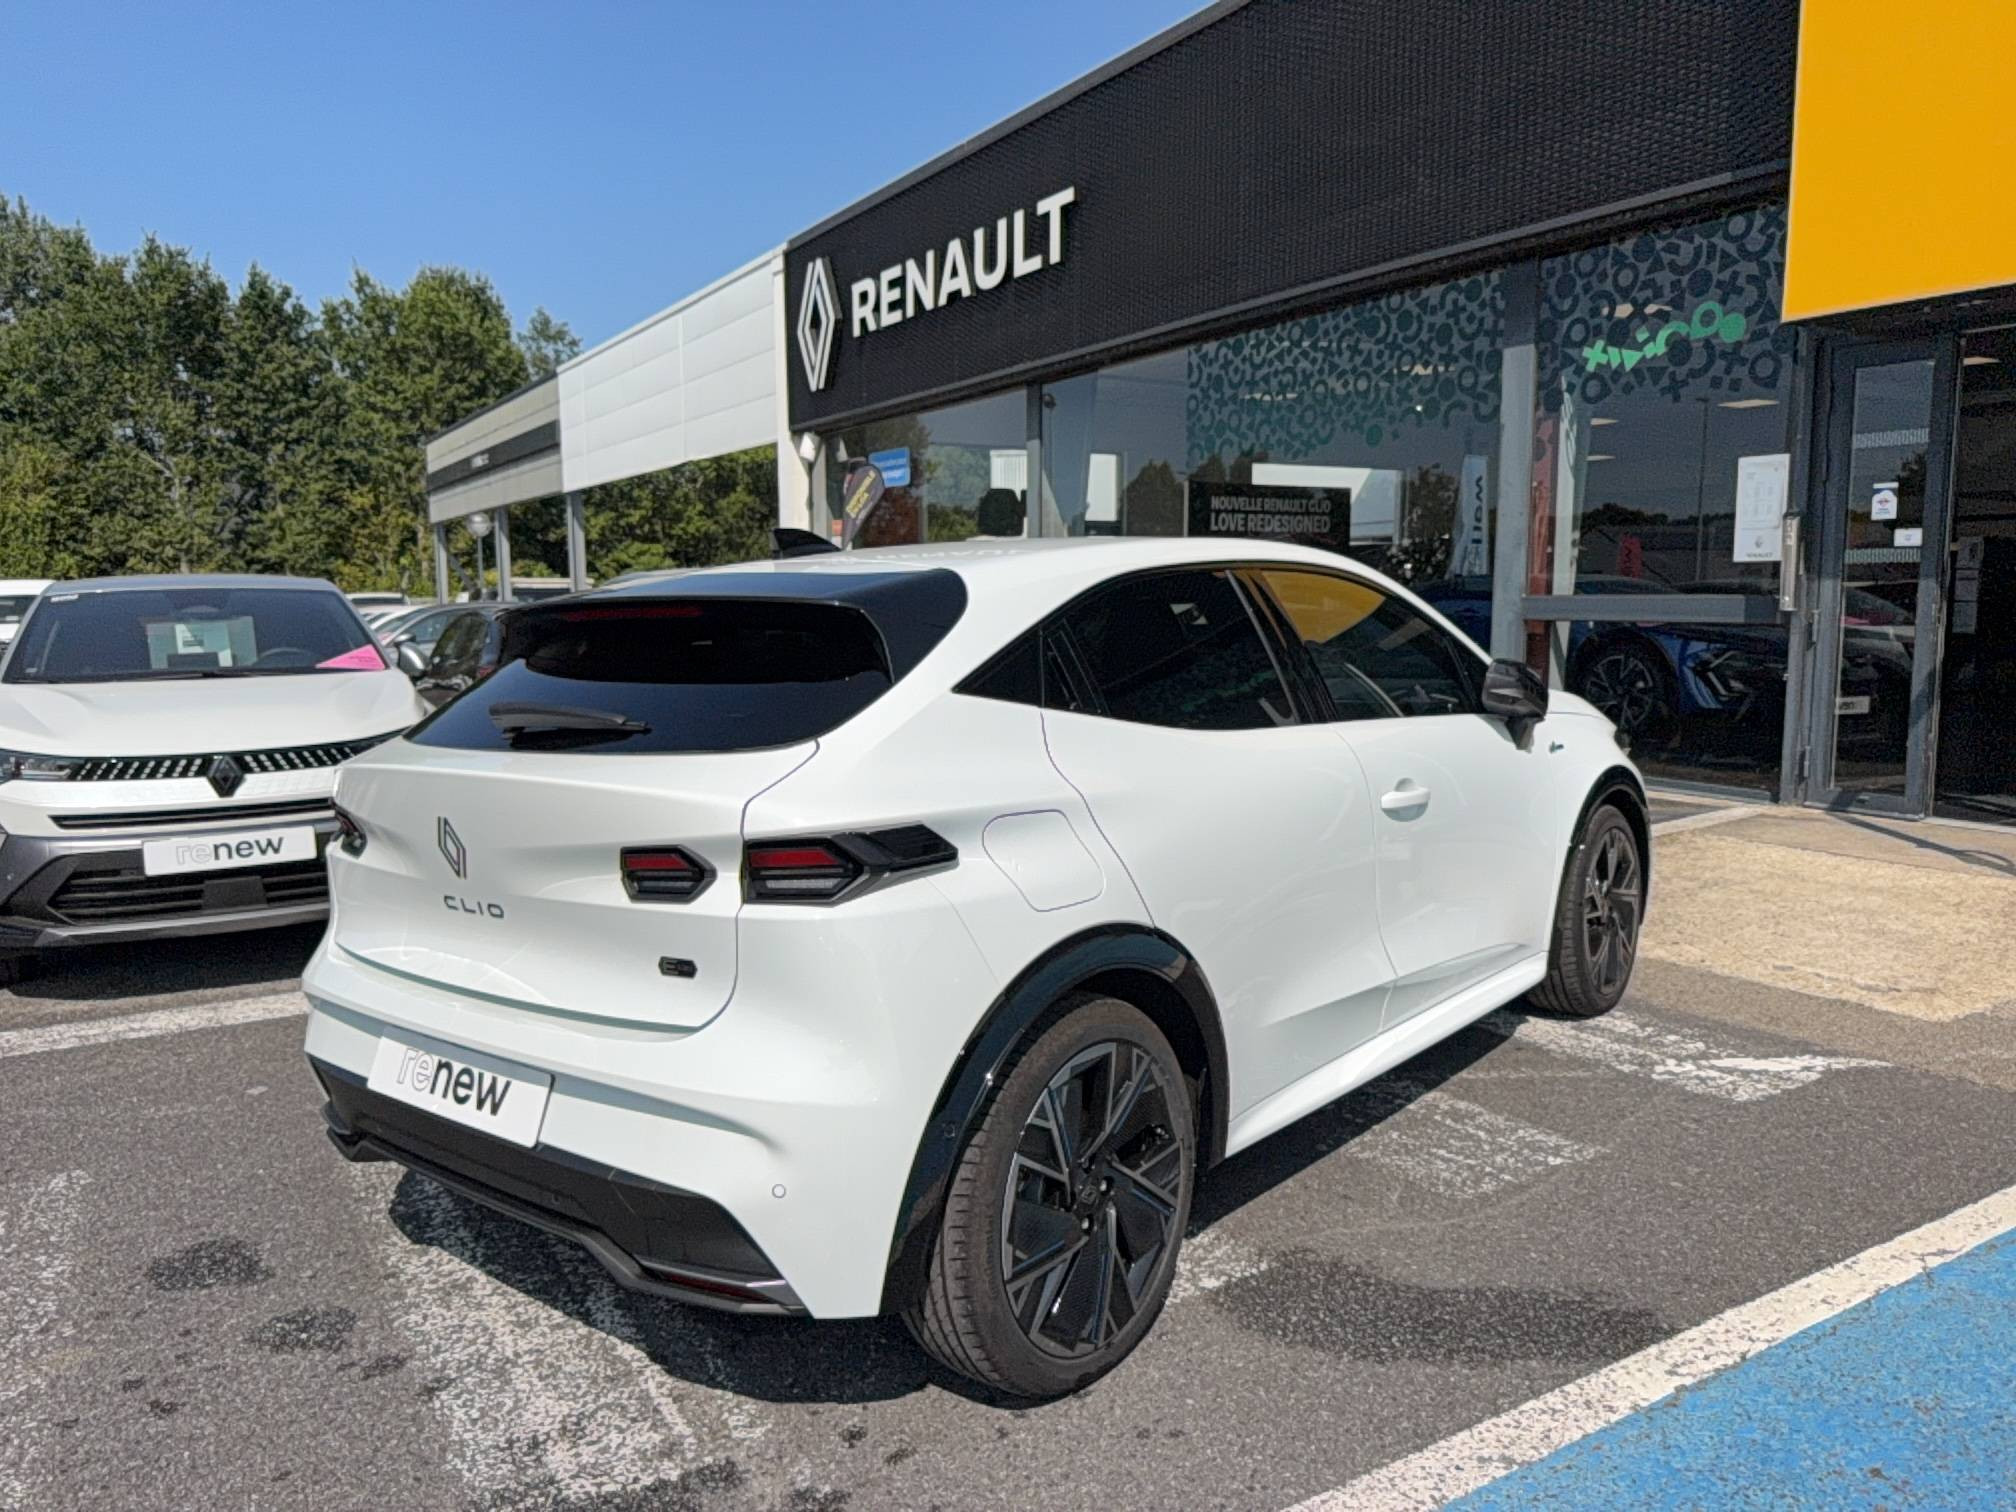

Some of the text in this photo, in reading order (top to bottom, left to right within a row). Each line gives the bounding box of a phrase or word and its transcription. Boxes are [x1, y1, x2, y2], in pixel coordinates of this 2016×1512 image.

[851, 186, 1075, 338] RENAULT
[1210, 495, 1263, 511] NOUVELLE
[1263, 497, 1308, 513] RENAULT
[1210, 512, 1331, 533] LOVE REDESIGNED
[176, 836, 285, 865] renew
[443, 895, 505, 919] CLIO
[396, 1047, 512, 1117] renew
